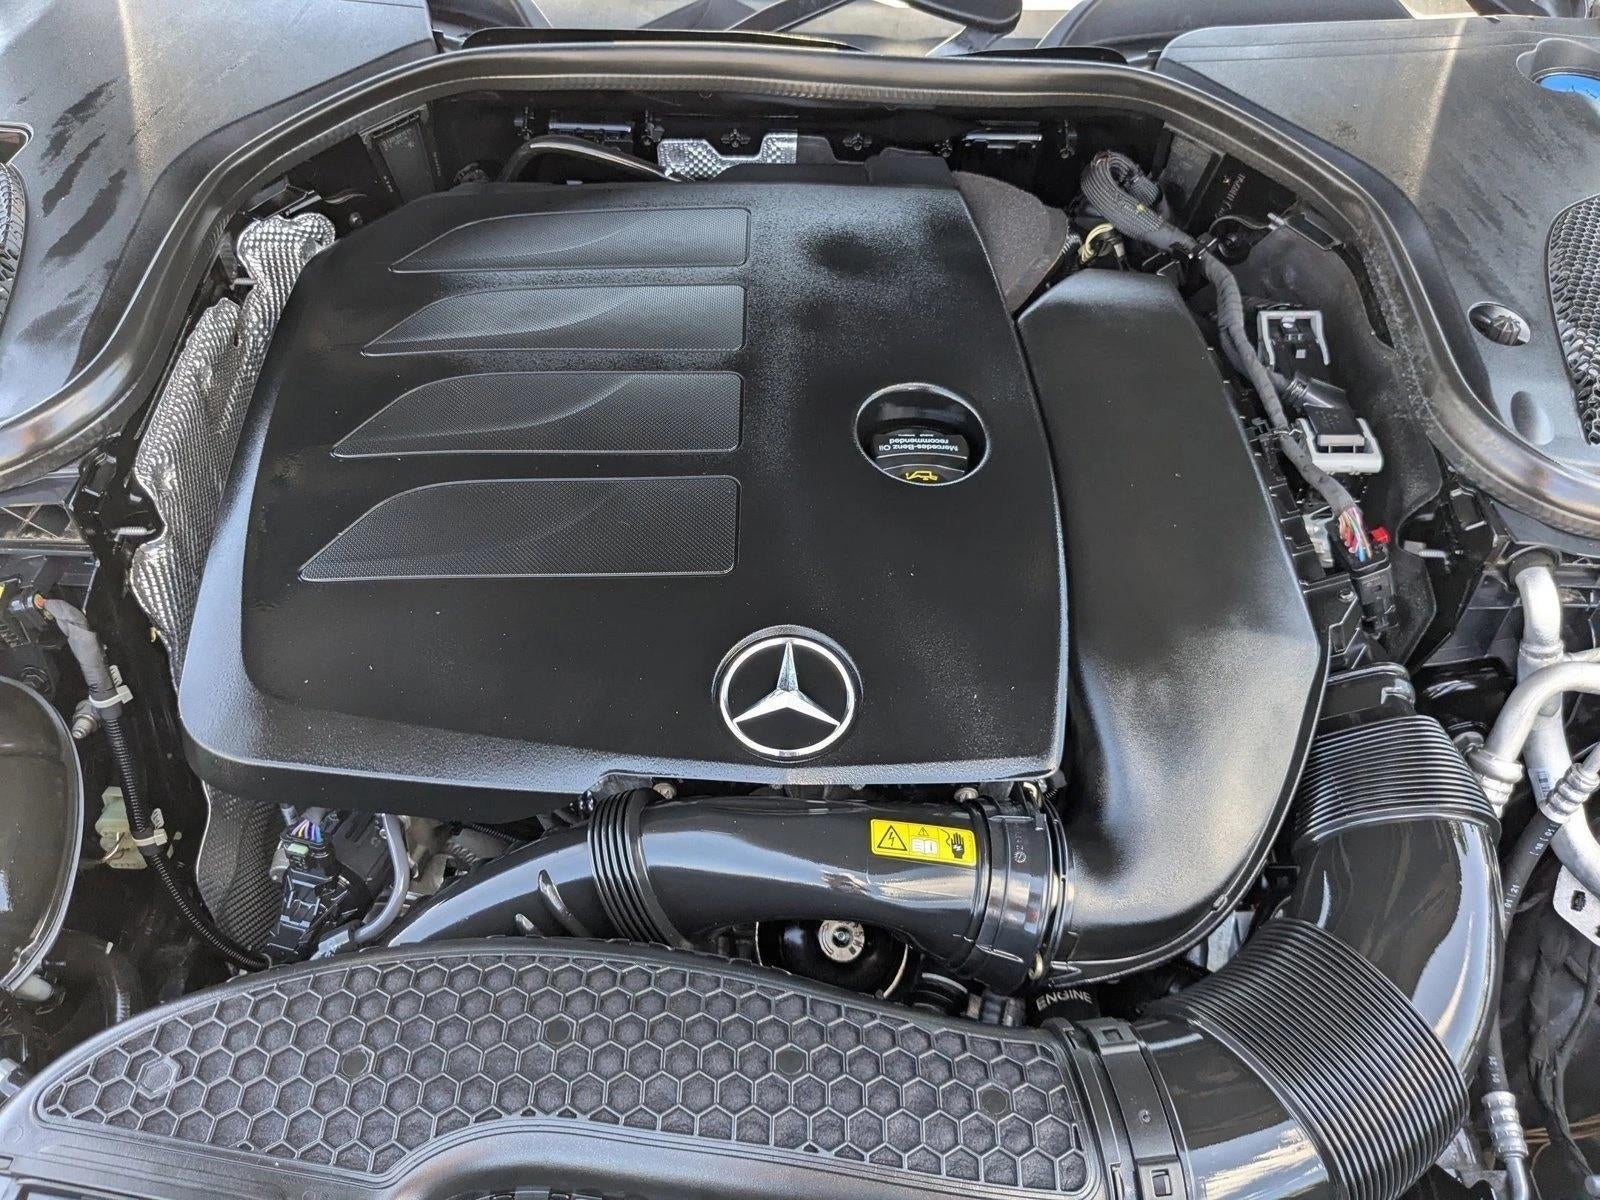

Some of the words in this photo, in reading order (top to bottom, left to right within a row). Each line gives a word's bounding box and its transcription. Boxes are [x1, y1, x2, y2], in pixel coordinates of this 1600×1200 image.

[879, 444, 891, 452] Oil
[892, 444, 959, 452] Mercedes-Benz
[1036, 989, 1094, 1012] ENGINE
